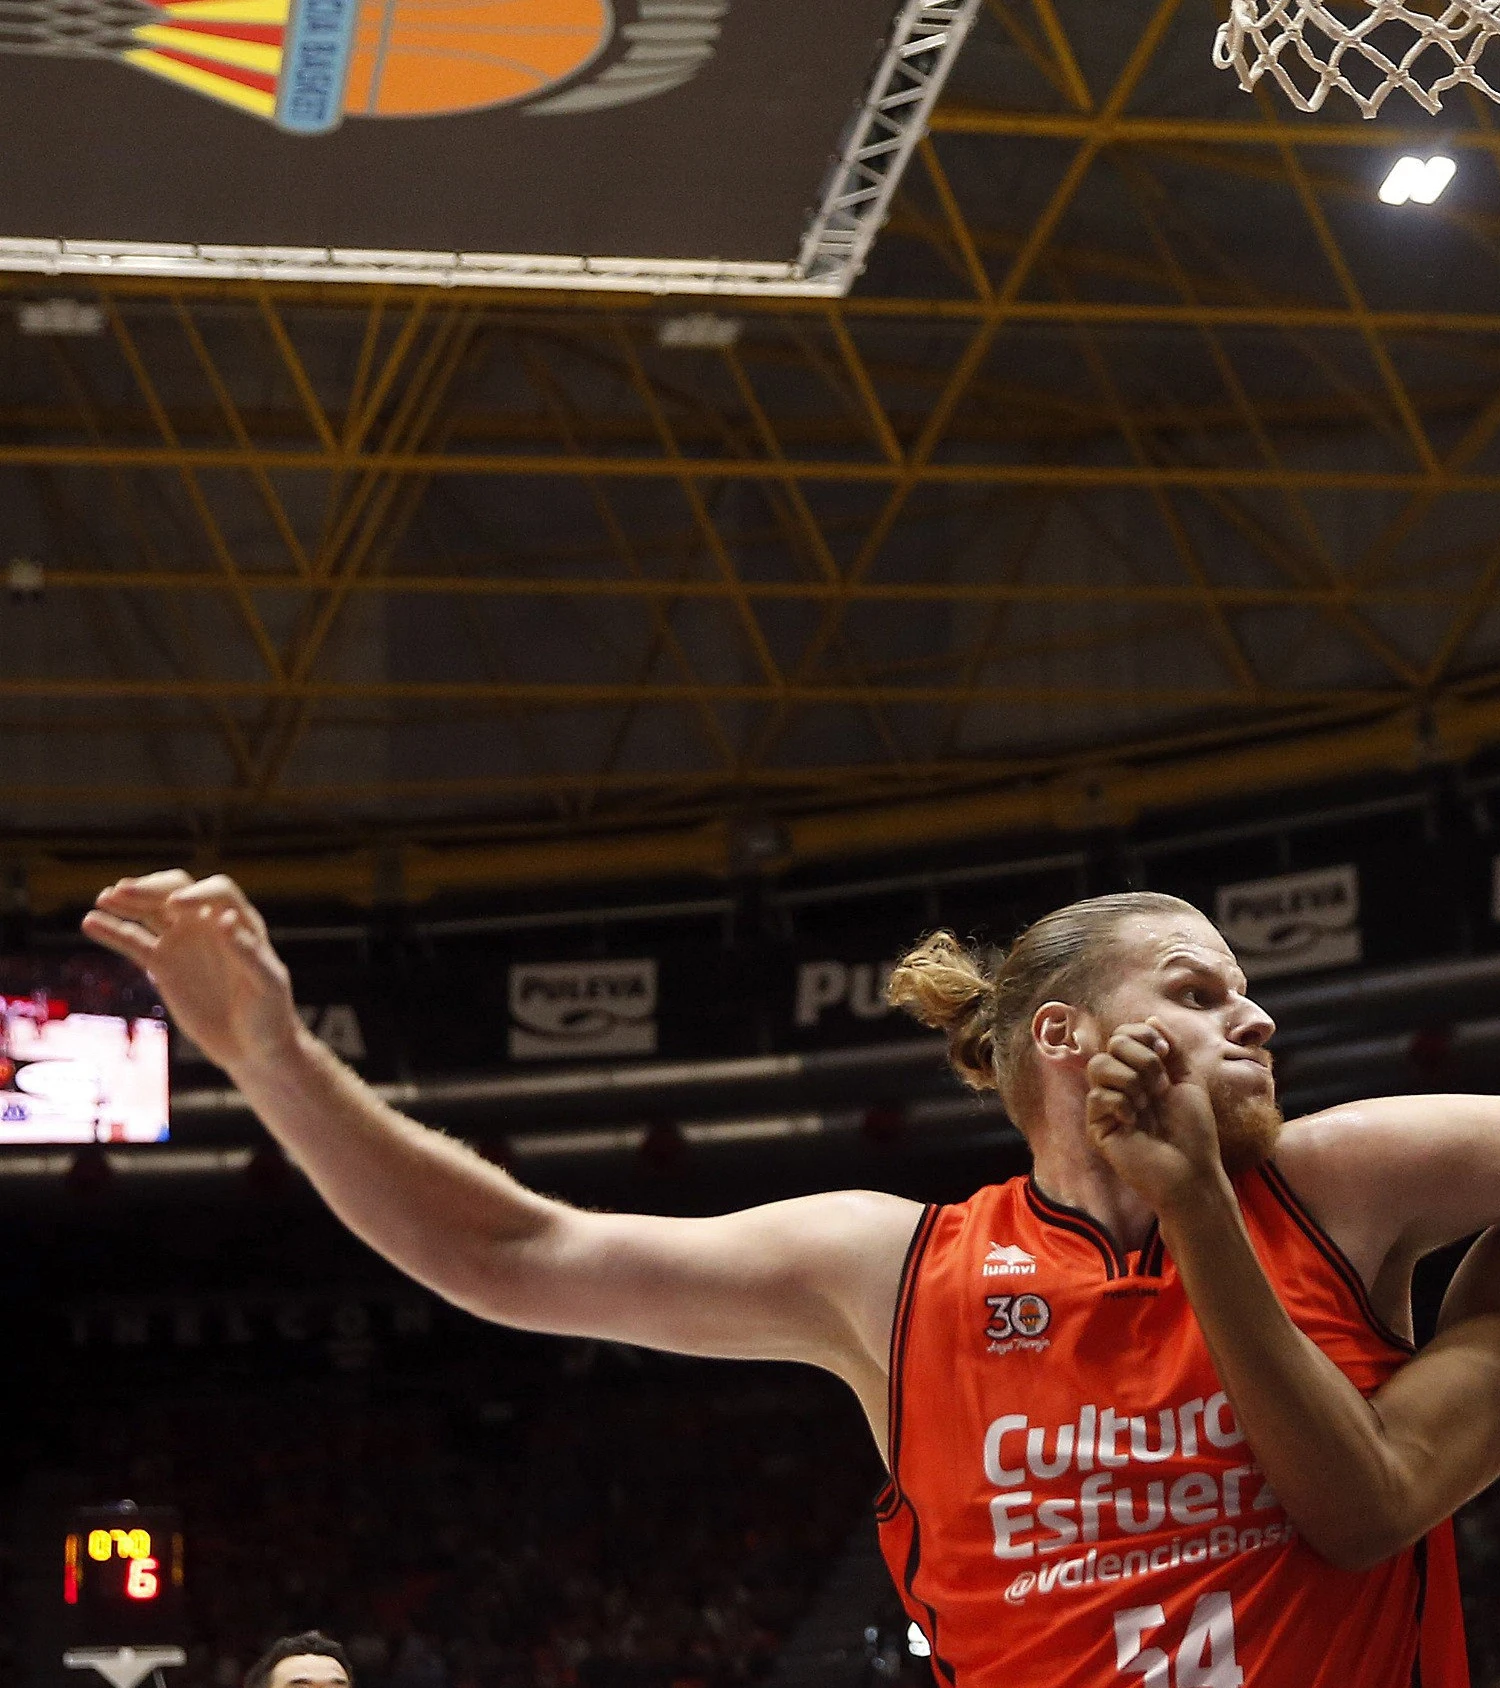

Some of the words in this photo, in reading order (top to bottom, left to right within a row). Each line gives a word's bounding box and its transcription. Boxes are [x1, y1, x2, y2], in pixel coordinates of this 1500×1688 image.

[985, 1293, 1050, 1339] 30
[127, 1556, 160, 1599] 6
[1113, 1590, 1245, 1688] 54
